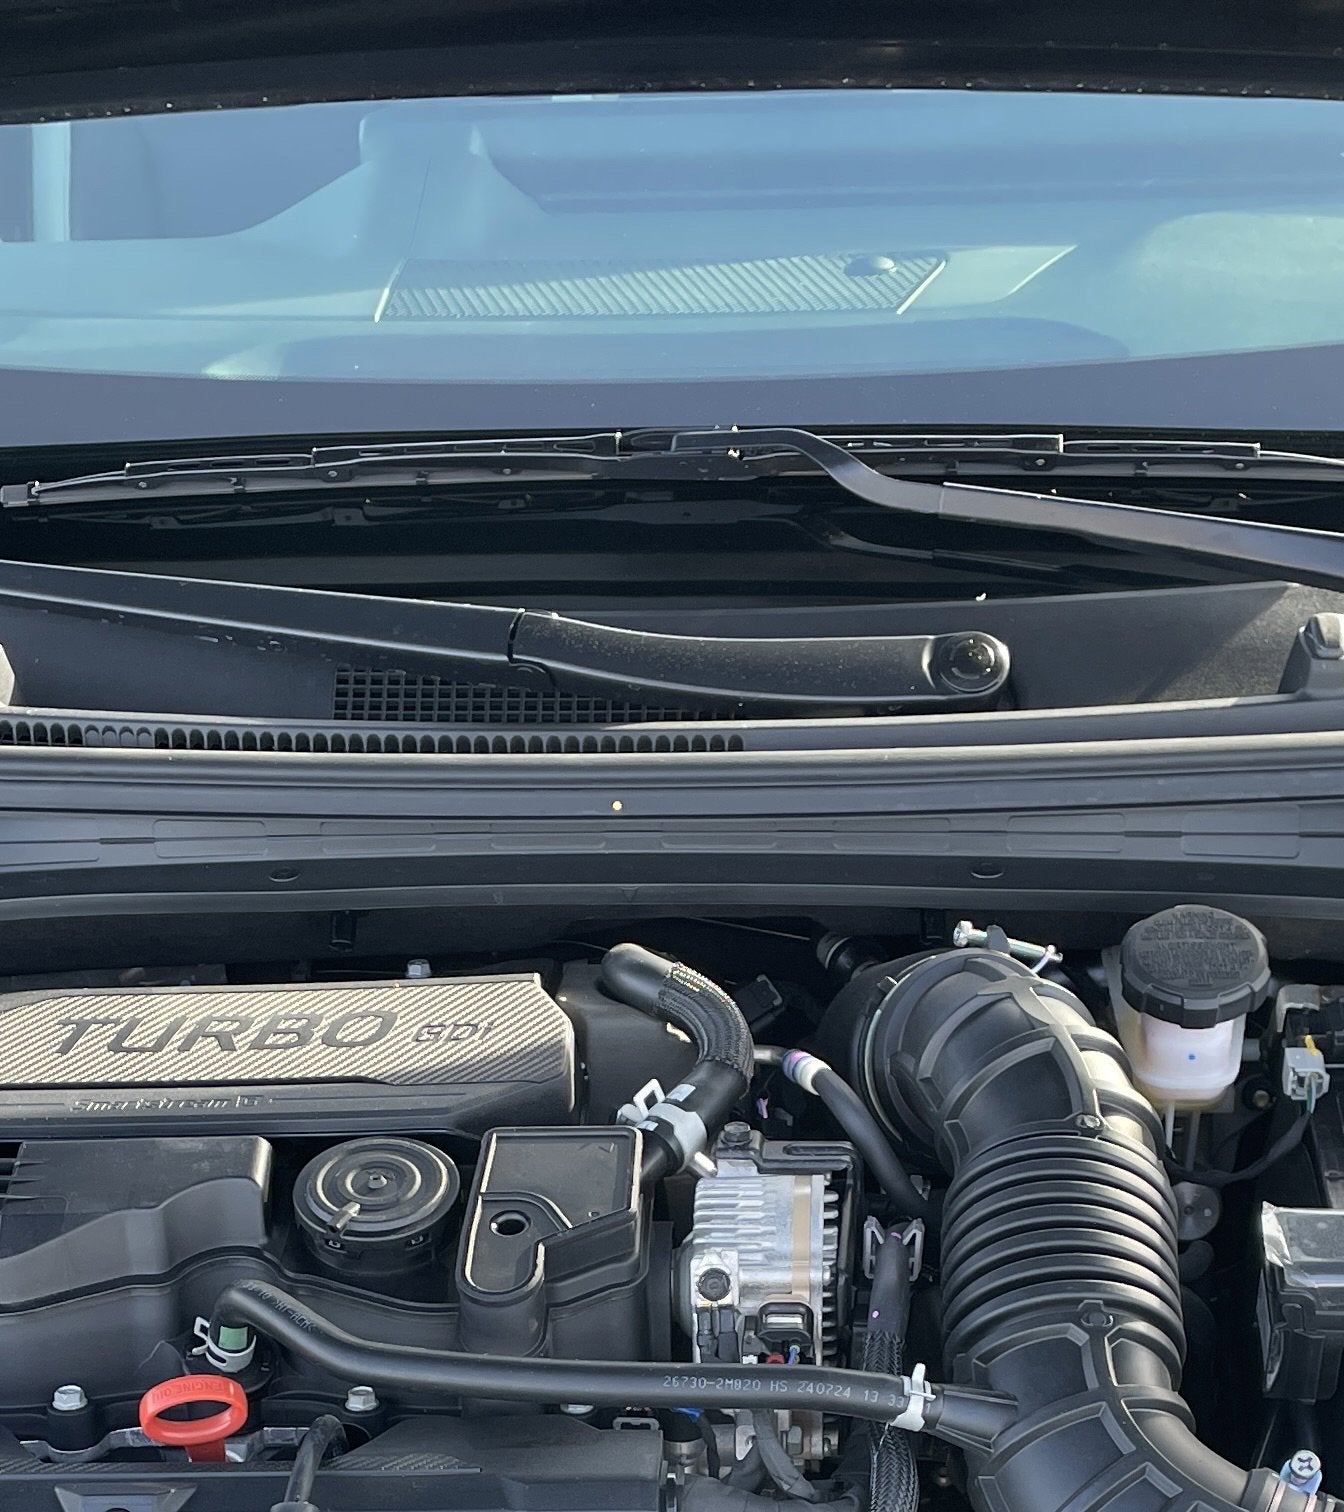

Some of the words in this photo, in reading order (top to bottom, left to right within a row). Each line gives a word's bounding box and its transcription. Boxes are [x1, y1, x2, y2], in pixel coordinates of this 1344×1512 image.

[56, 1010, 398, 1056] TURBO
[411, 1021, 494, 1043] GDi
[69, 1097, 231, 1113] Smartstream
[151, 1387, 173, 1403] OIL
[175, 1380, 224, 1395] ENGINE
[769, 1380, 788, 1392] HS
[796, 1380, 852, 1399] 240724
